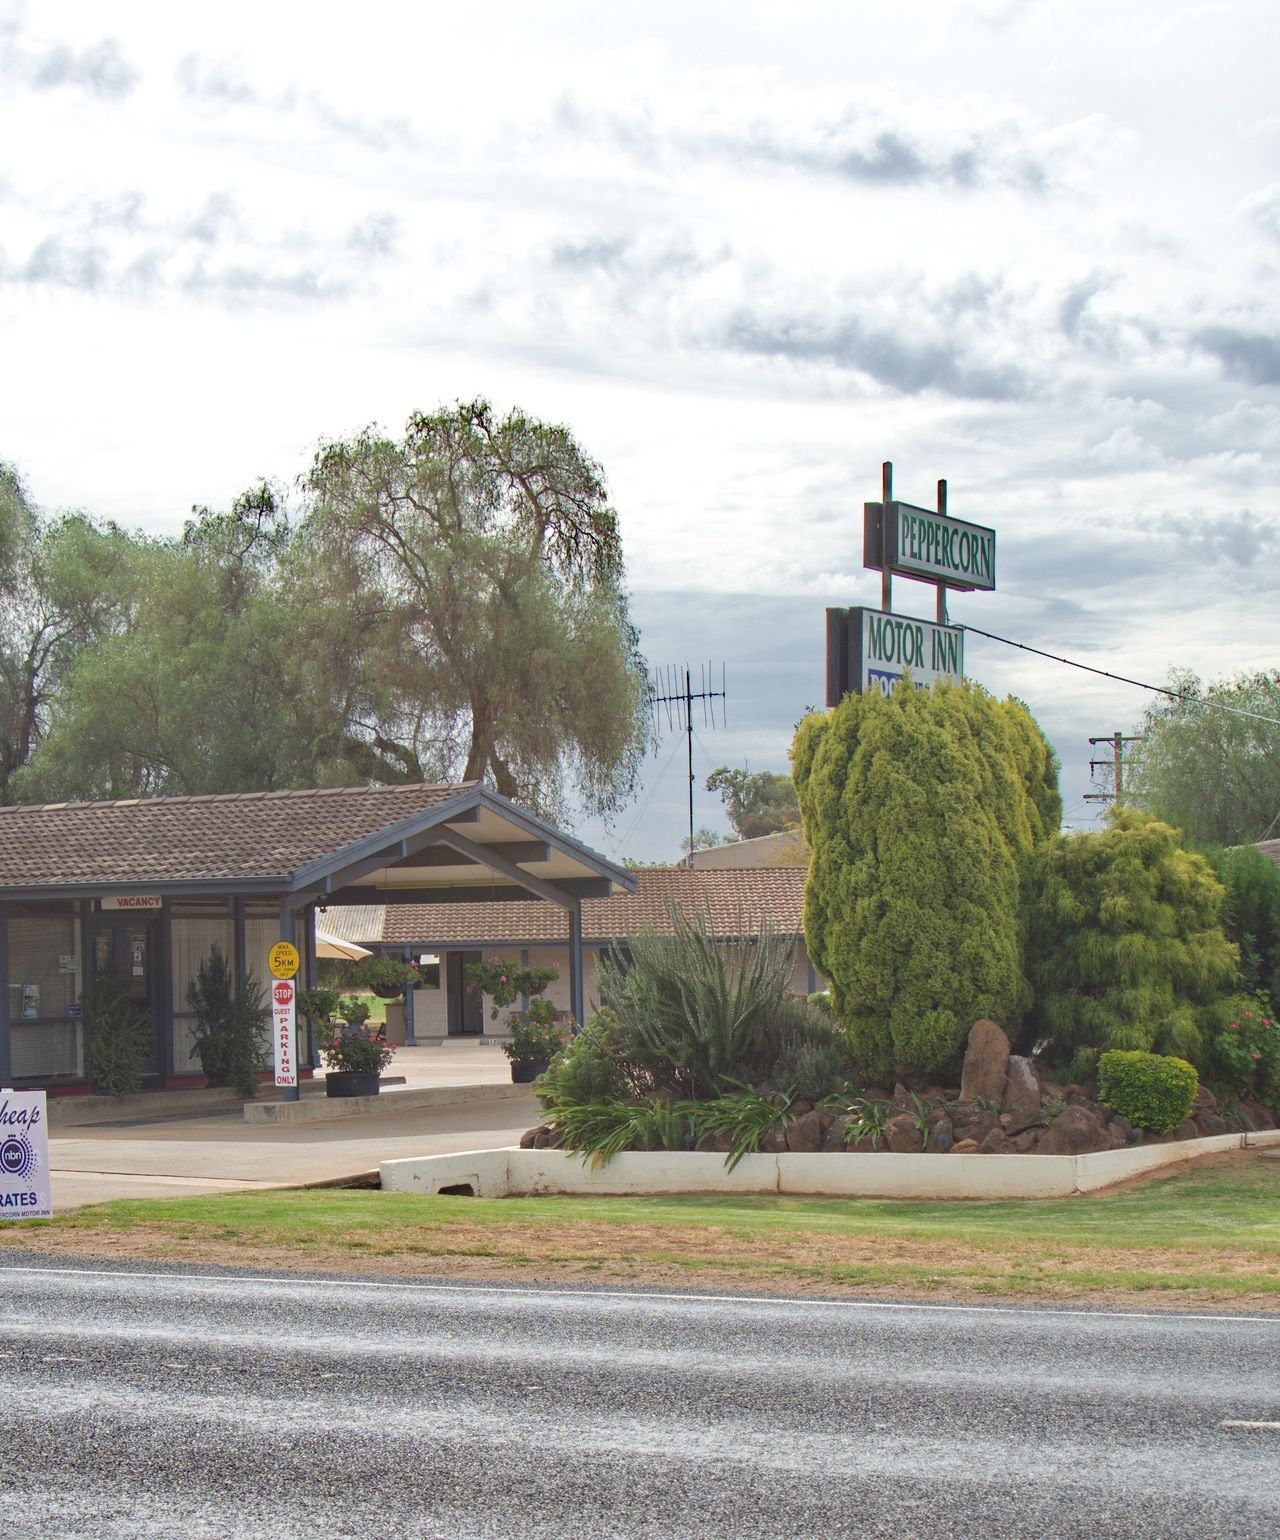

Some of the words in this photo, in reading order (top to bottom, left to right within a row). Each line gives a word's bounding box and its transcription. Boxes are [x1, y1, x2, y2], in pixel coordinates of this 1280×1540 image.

[901, 514, 991, 579] PEPPERCORN
[868, 615, 924, 668] MOTOR
[931, 628, 959, 674] INN
[117, 896, 161, 907] VACANCY
[274, 956, 294, 968] 5KM
[274, 989, 293, 999] STOP
[280, 1017, 290, 1073] PARKING
[276, 1075, 296, 1085] ONLY
[5, 1150, 22, 1160] nbn
[20, 1209, 41, 1218] MOTOR
[40, 1208, 51, 1217] INN
